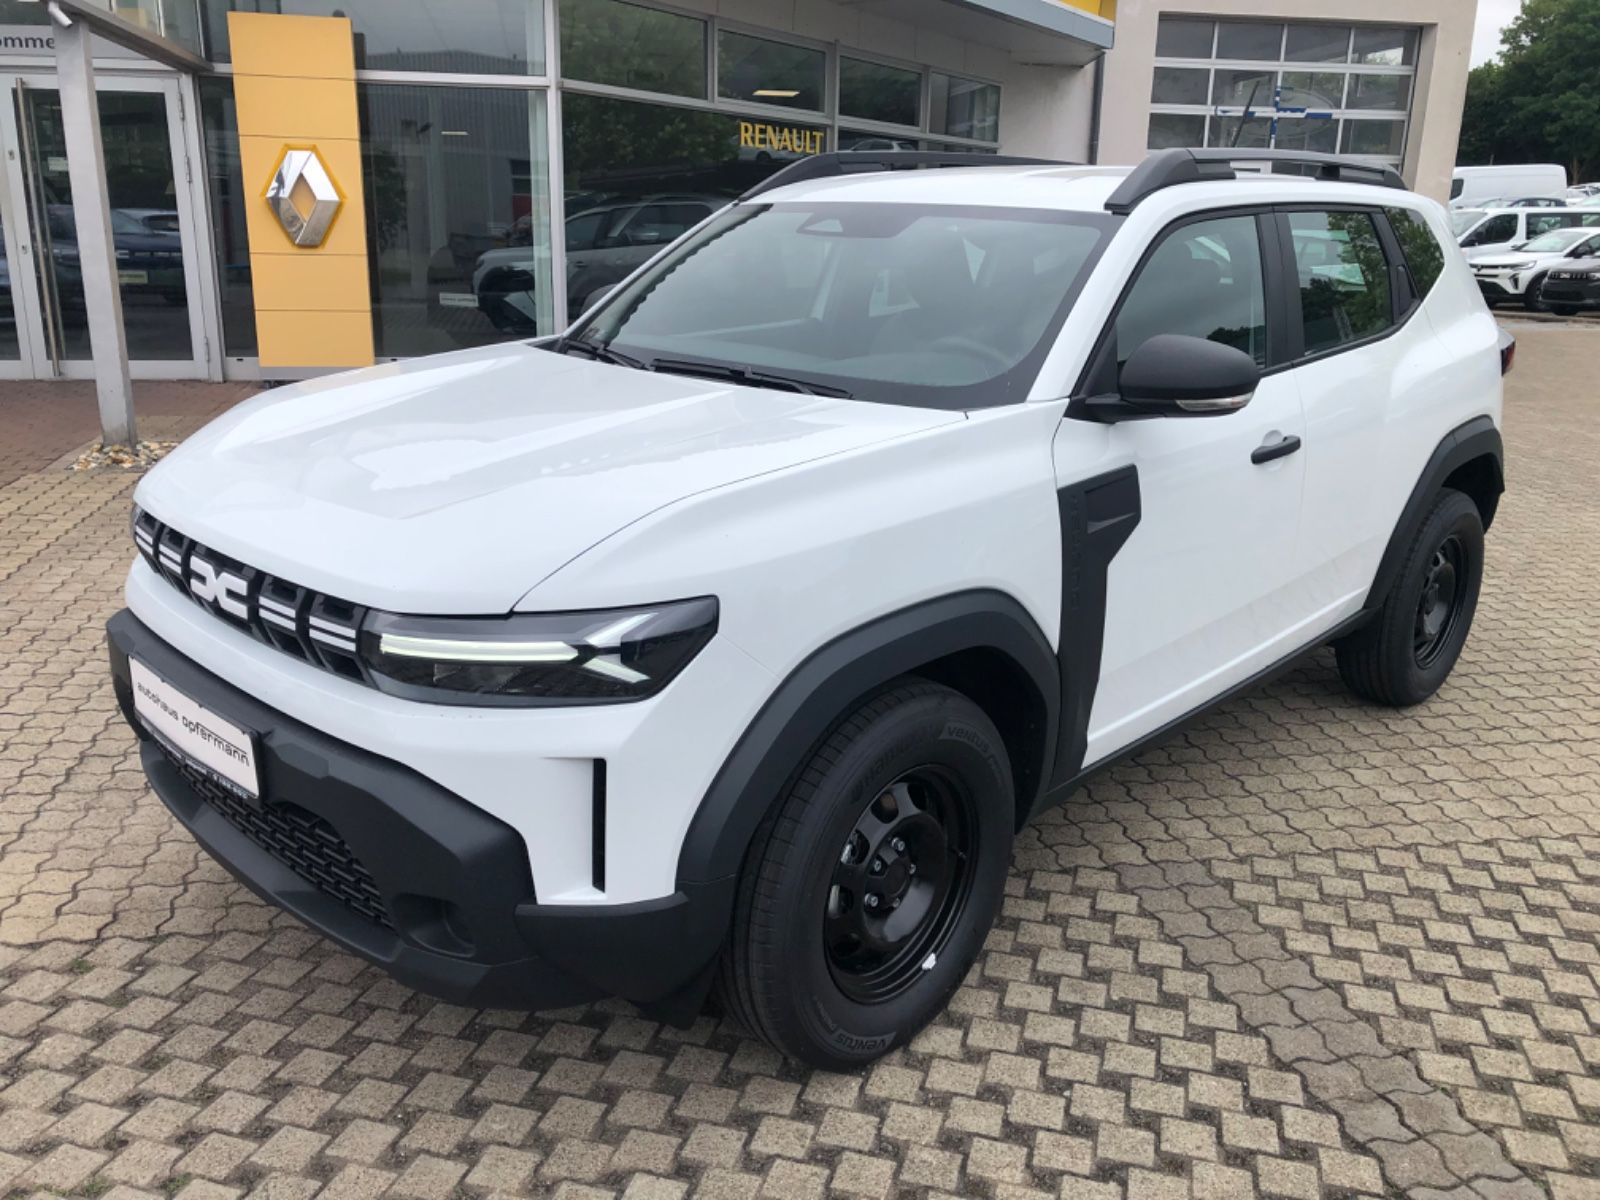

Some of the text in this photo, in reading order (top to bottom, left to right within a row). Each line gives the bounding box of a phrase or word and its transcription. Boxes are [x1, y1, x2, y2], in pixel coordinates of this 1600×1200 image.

[740, 121, 824, 155] RENAULT
[137, 681, 250, 767] autohaus opfermann
